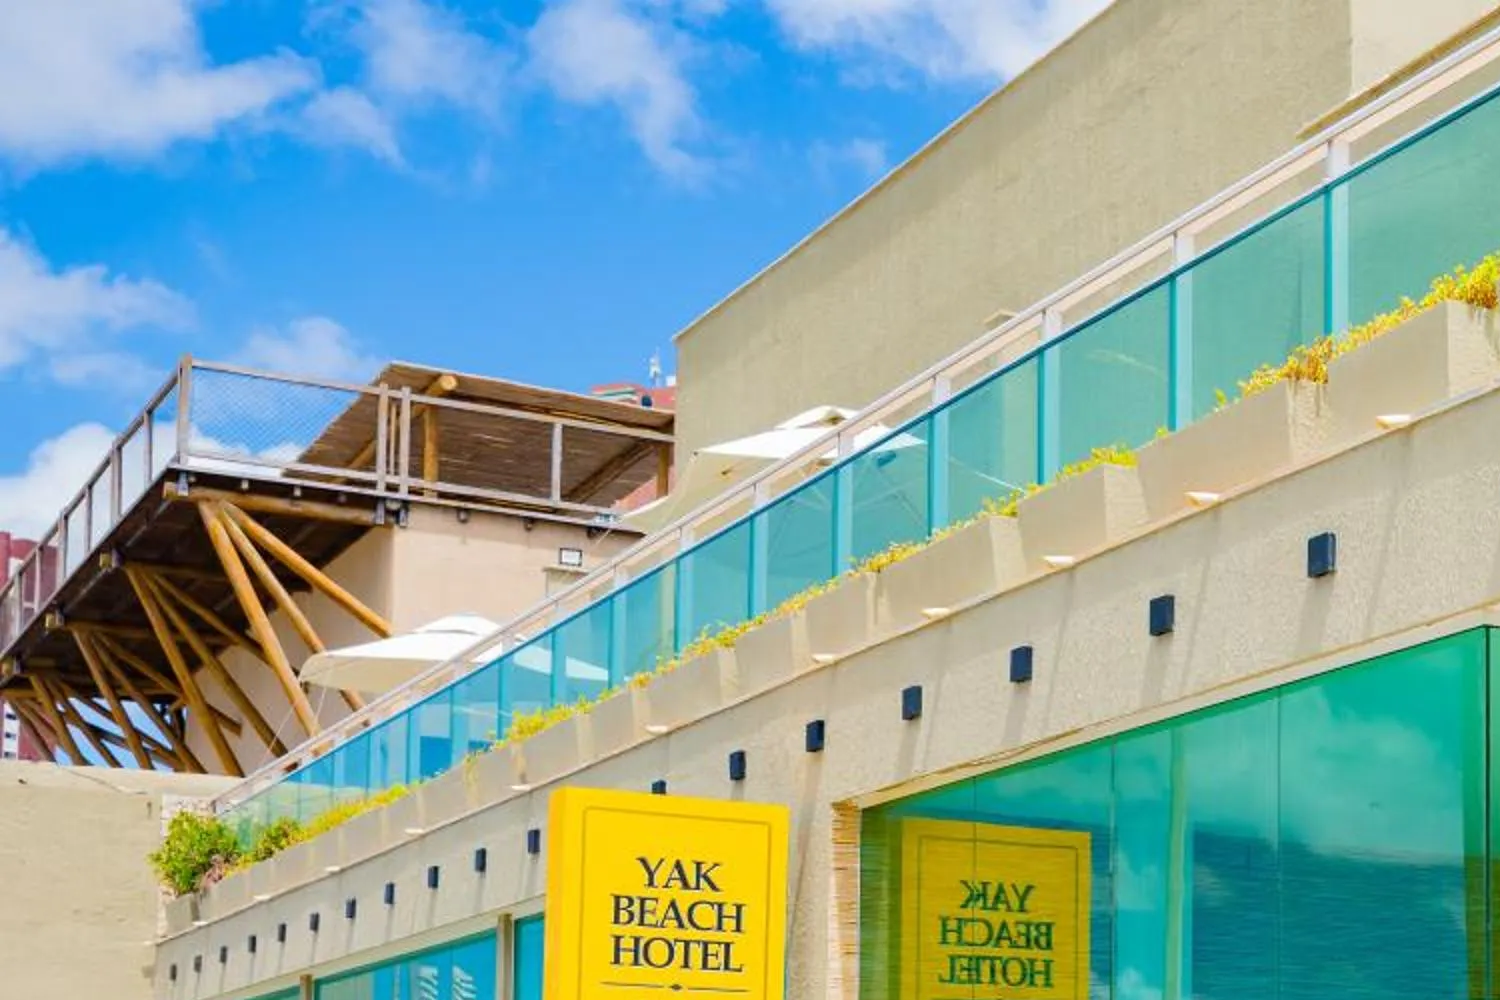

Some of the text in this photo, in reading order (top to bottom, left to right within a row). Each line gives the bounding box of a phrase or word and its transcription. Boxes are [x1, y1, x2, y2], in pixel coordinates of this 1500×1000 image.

[635, 856, 723, 892] YAK
[610, 893, 746, 934] BEACH
[609, 934, 744, 973] HOTEL
